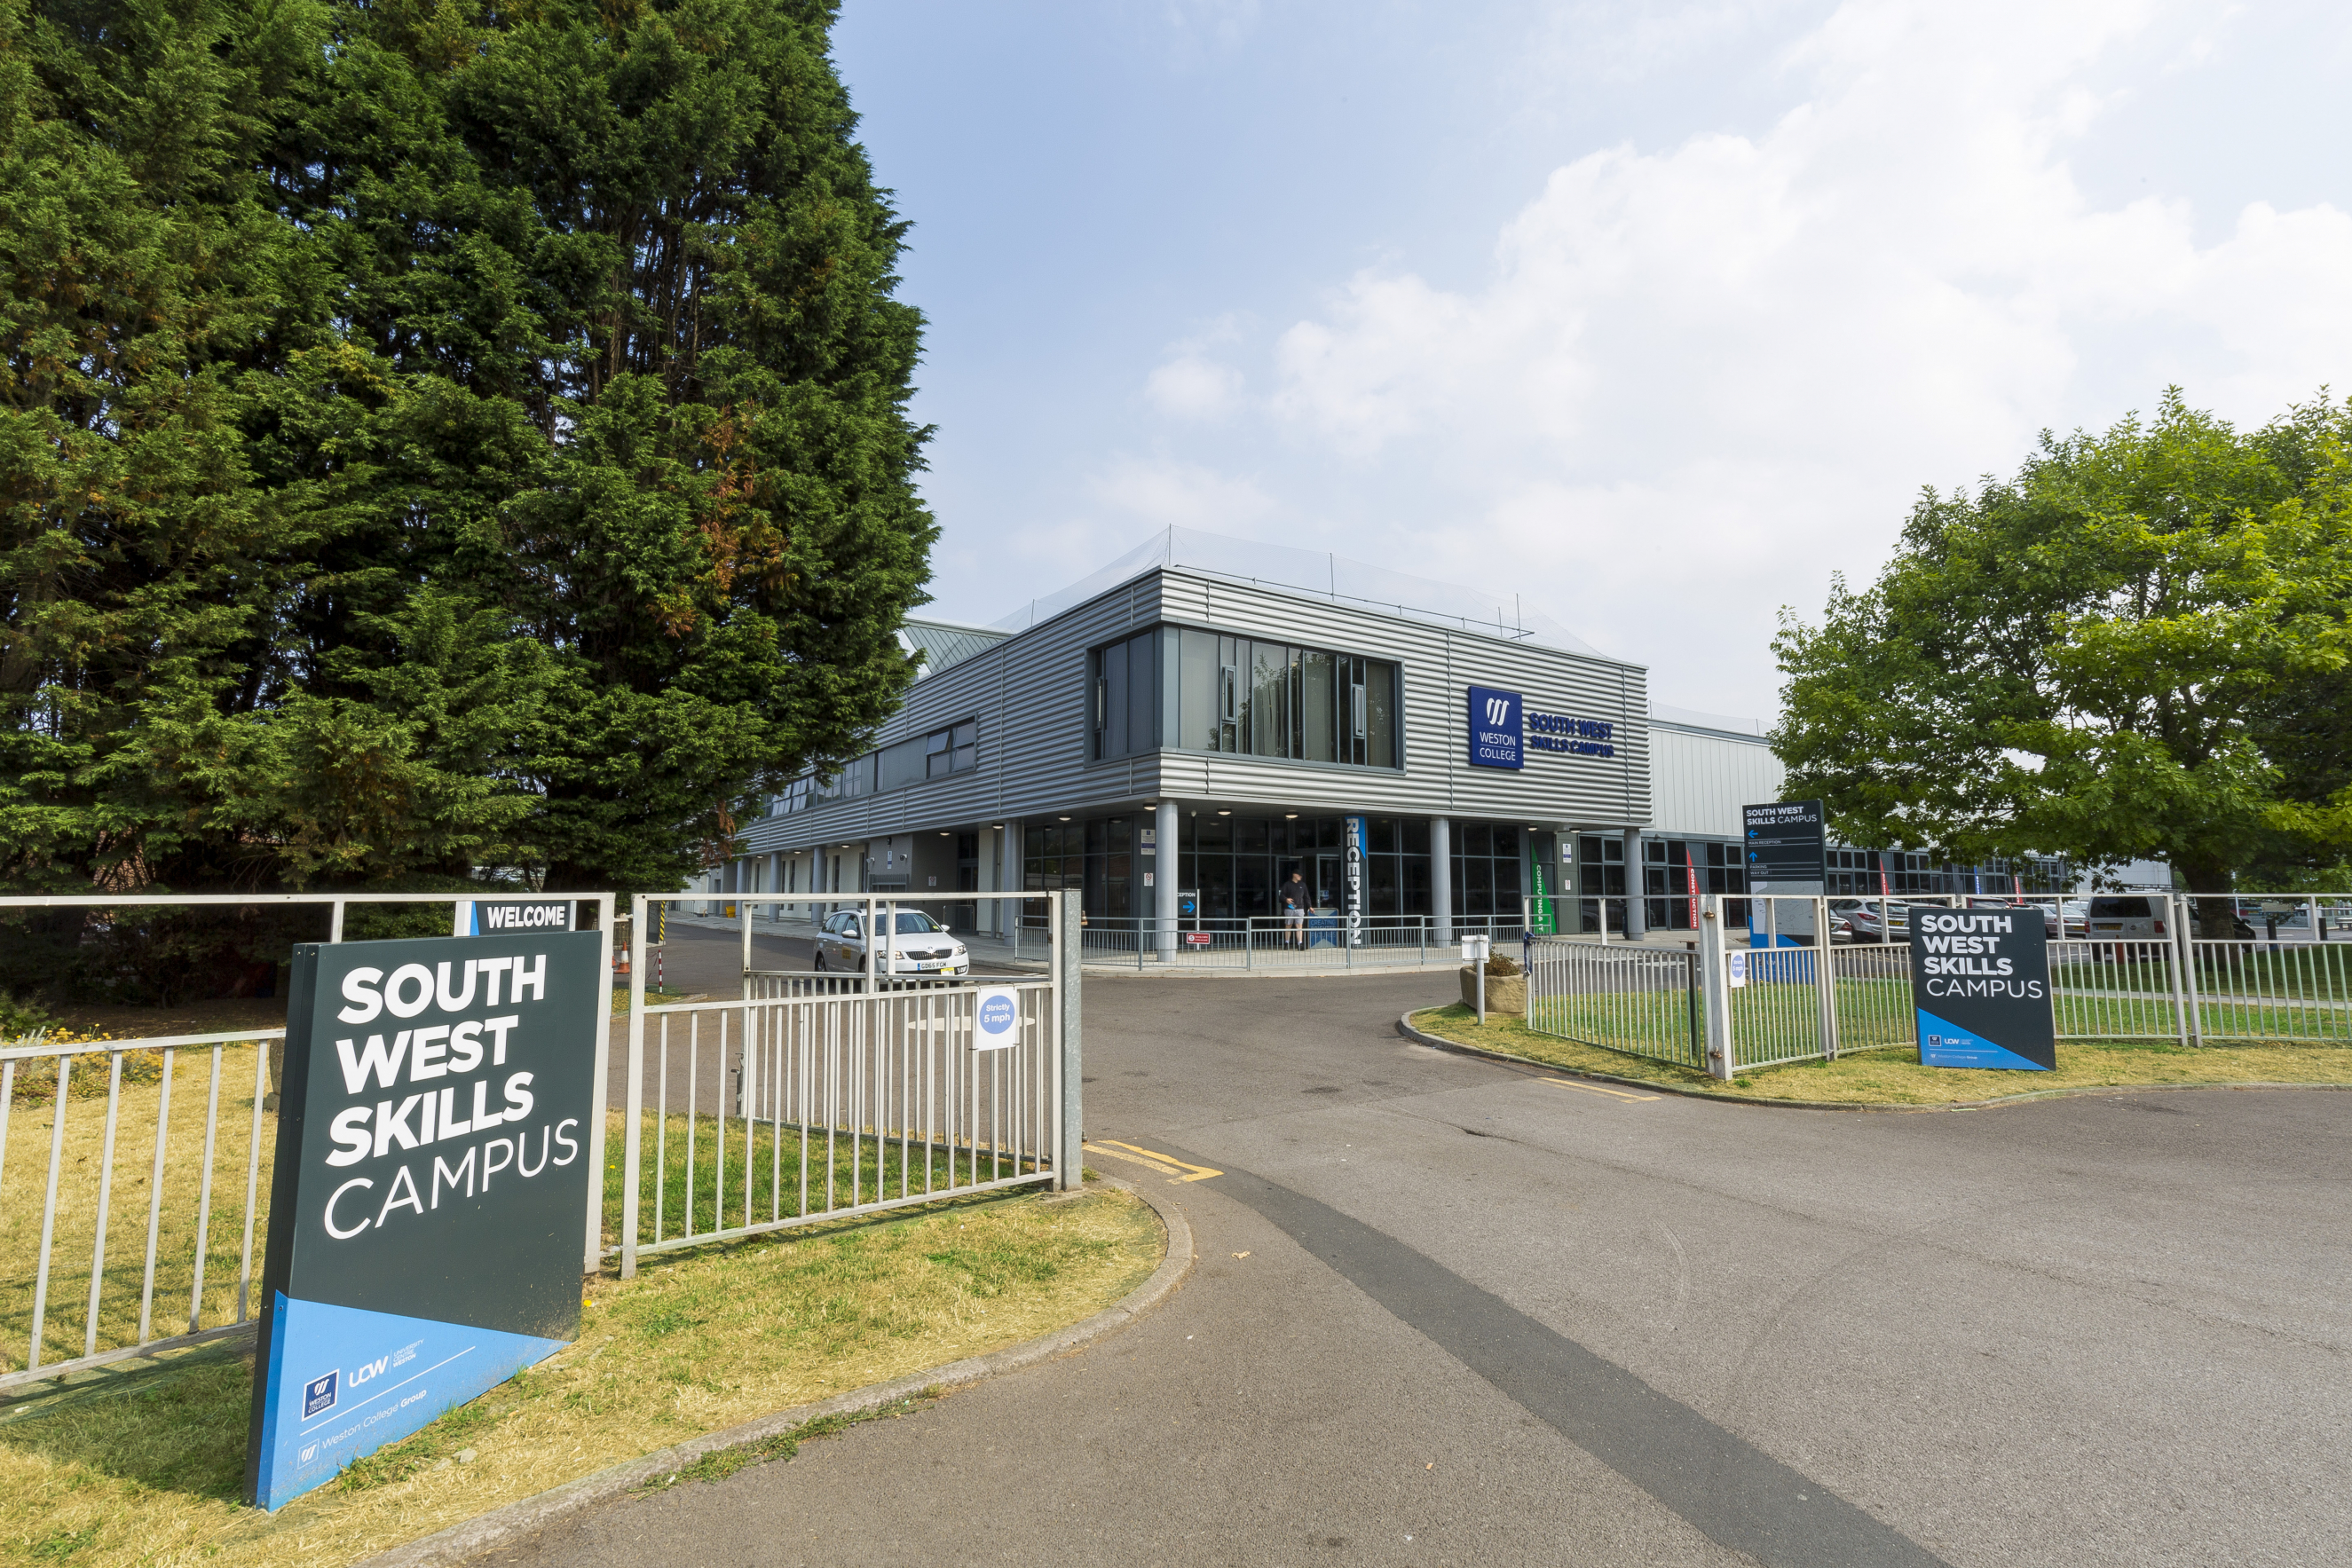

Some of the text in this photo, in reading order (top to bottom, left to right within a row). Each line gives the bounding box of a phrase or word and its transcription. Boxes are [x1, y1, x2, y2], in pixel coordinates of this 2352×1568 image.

[1529, 713, 1614, 740] SOUTH WEST
[1479, 731, 1516, 747] WESTON
[1530, 735, 1614, 757] SKILLS CAMPUS
[1480, 747, 1516, 761] COLLEGE
[1746, 806, 1803, 816] SOUTH WEST
[1747, 814, 1818, 825] SKILLS CAMPUS
[1346, 818, 1361, 945] RECEPTION
[486, 905, 565, 929] WELCOME
[1921, 914, 2013, 934] SOUTH
[1922, 935, 2001, 954] WEST
[1923, 956, 2014, 976] SKILLS
[337, 954, 547, 1024] SOUTH
[1926, 978, 2043, 999] CAMPUS
[985, 1003, 1010, 1012] Strictly
[983, 1012, 1011, 1024] 5 mph
[335, 1015, 519, 1094] WEST
[325, 1071, 534, 1167] SKILLS
[323, 1118, 579, 1239] CAMPUS
[393, 1338, 424, 1357] UNIVERSITY
[393, 1348, 414, 1362] CENTRE
[392, 1352, 416, 1368] WESTON
[348, 1355, 389, 1388] UCW
[308, 1399, 331, 1414] COLLEGE
[309, 1391, 332, 1406] WESTON
[321, 1390, 427, 1449] Weston College Group
